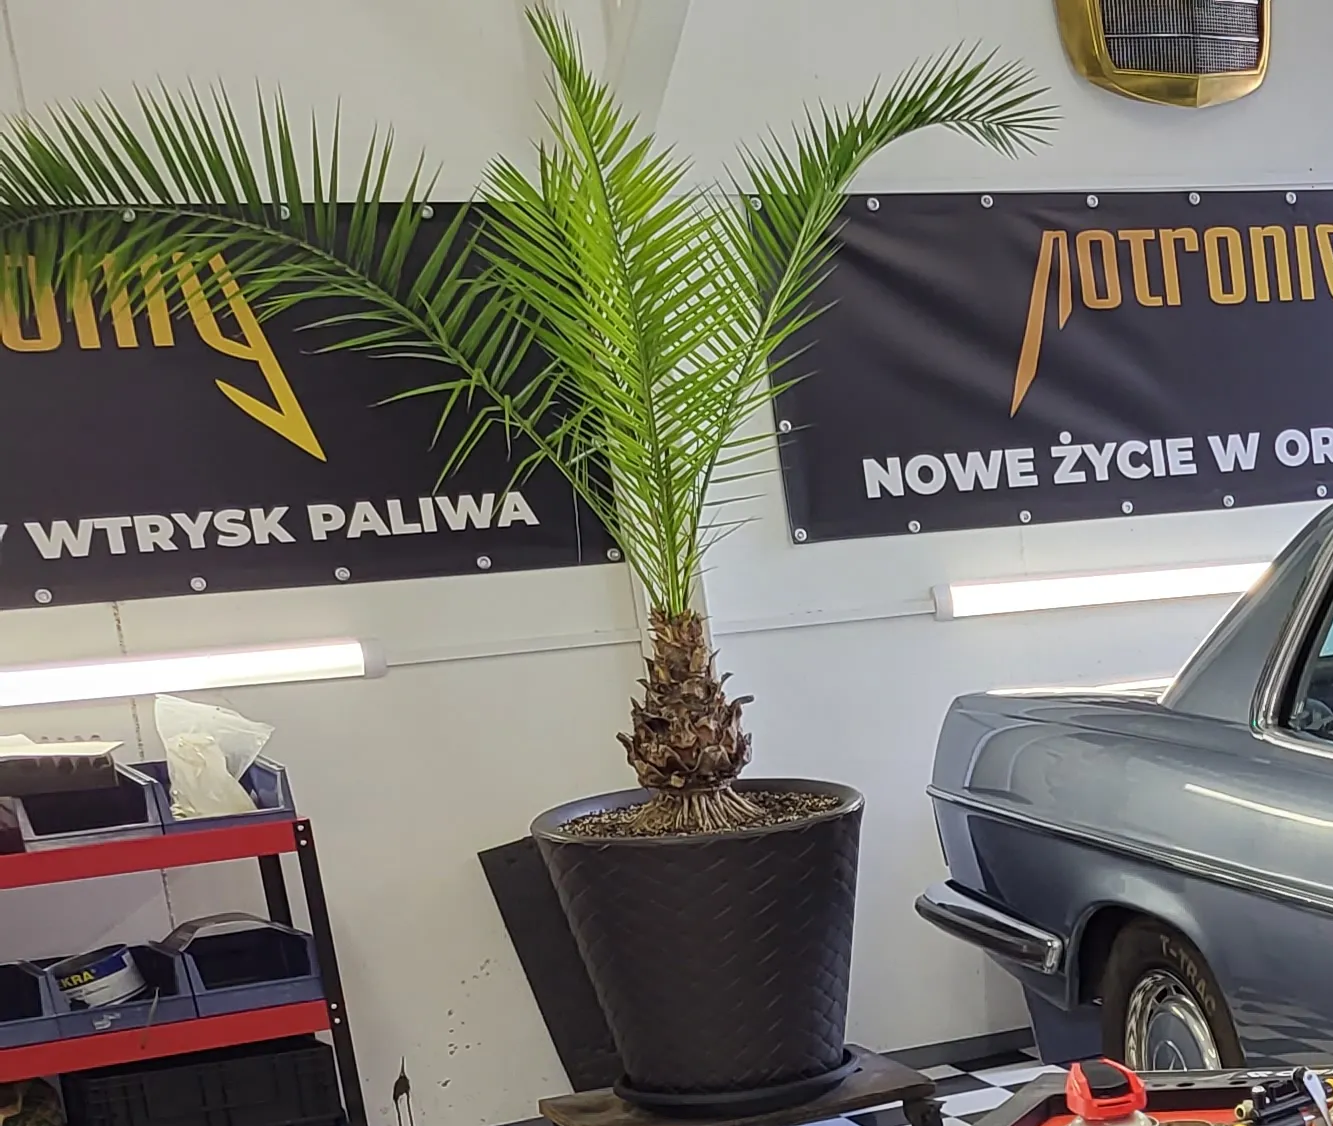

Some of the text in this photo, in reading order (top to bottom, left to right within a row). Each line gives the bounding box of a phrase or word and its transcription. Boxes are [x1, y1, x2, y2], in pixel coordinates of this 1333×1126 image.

[863, 447, 1039, 499] NOWE
[1051, 431, 1197, 484] ŻYCIE
[1207, 432, 1260, 472] W
[24, 491, 540, 560] WTRYSK PALIWA
